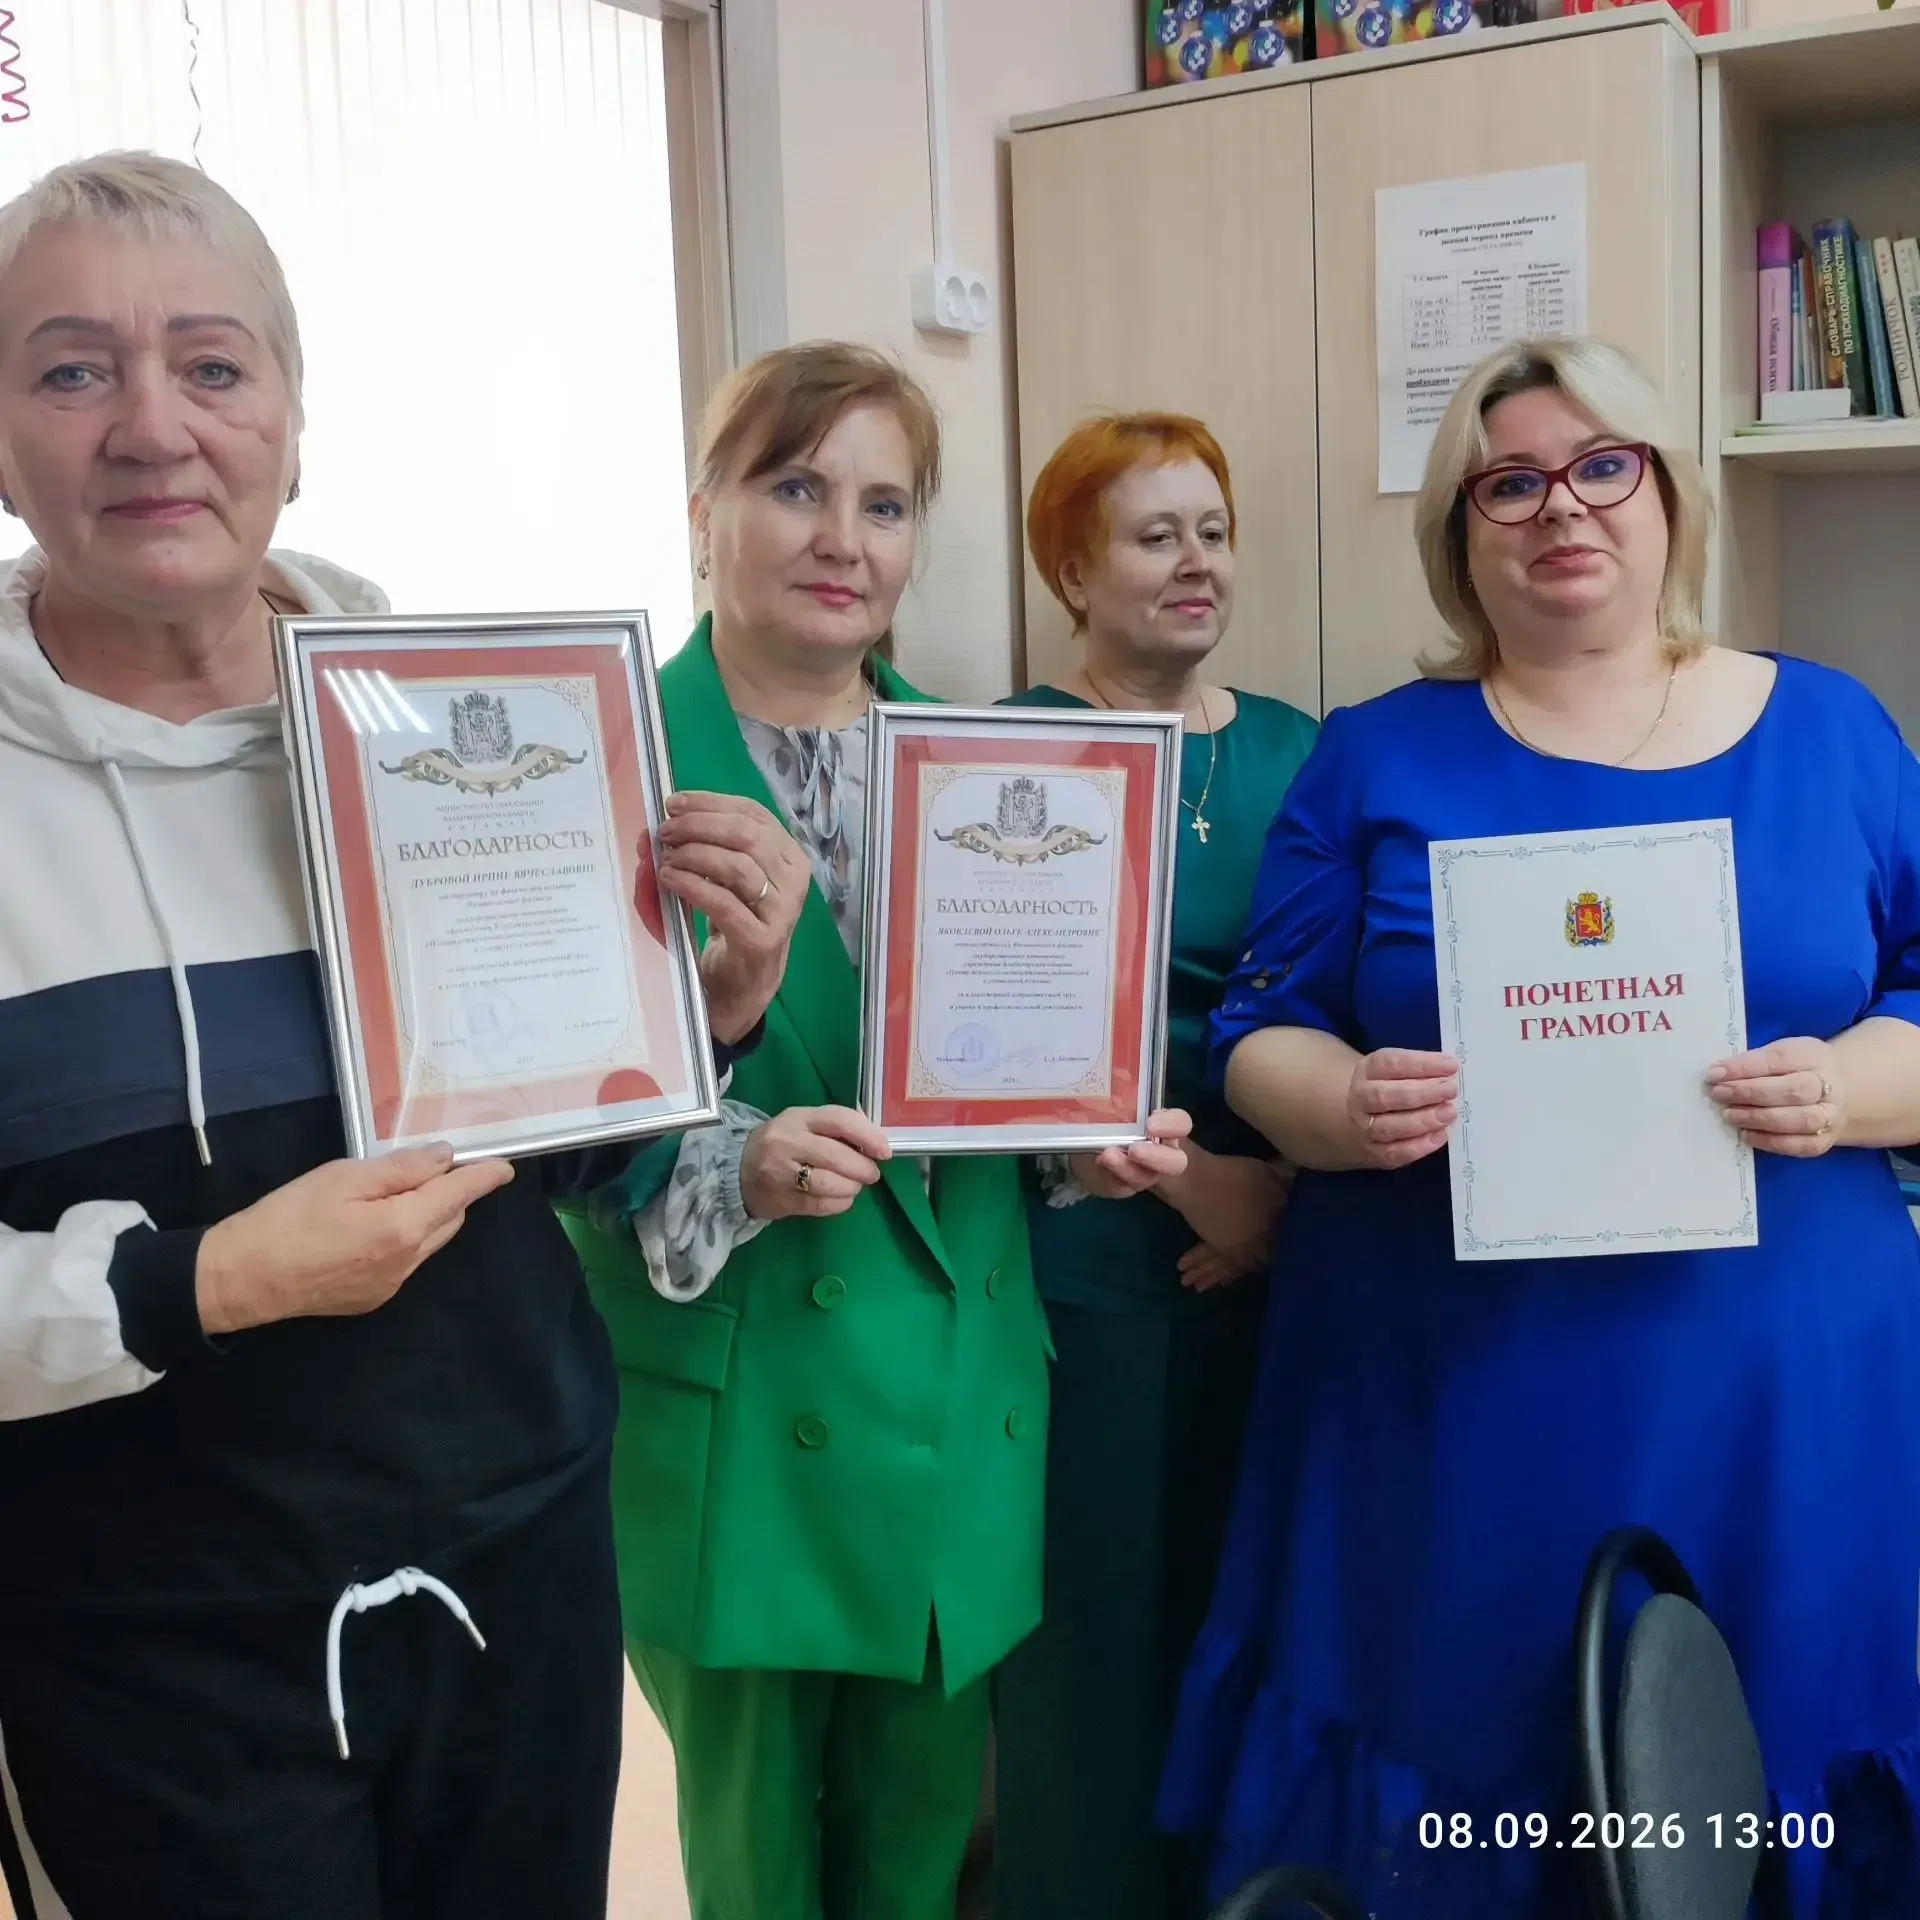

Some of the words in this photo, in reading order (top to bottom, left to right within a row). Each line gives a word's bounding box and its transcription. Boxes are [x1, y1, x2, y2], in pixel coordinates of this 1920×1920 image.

[1819, 237, 1841, 356] СЛОВАРЬ-СПРАВОЧНИК
[1833, 235, 1853, 337] ПСИХОДИАГНОСТИКЕ
[1843, 338, 1853, 354] ПО
[397, 830, 595, 862] БЛАГОДАРНОСТЬ
[411, 872, 470, 889] ДУБРОВОЙ
[936, 898, 1099, 915] БЛАГОДАРНОСТЬ
[1503, 973, 1685, 1008] ПОЧЕТНАЯ
[1520, 1009, 1673, 1040] ГРАМОТА
